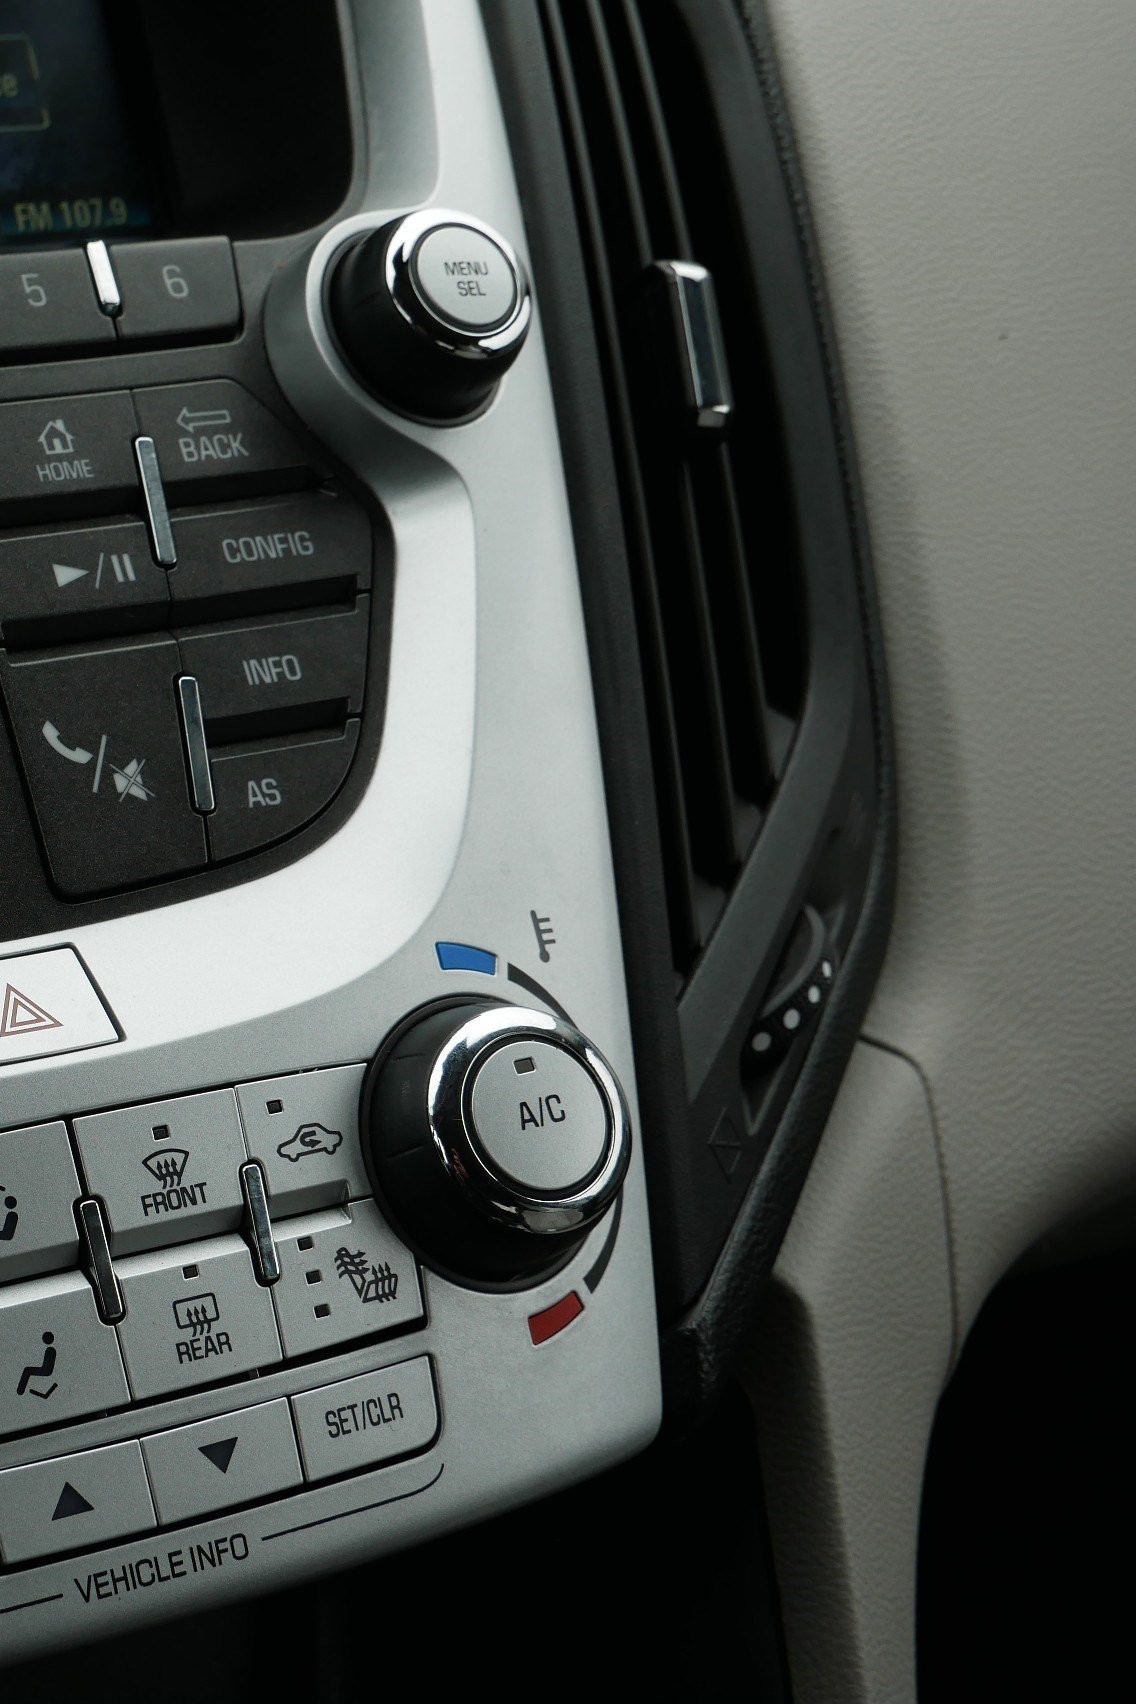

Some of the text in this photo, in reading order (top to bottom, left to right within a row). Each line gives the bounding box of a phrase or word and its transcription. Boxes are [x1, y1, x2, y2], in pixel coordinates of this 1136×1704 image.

[14, 197, 128, 232] FM 107.9
[162, 264, 190, 299] 6
[444, 261, 489, 276] MENU
[21, 272, 48, 308] 5
[456, 281, 486, 296] SEL
[178, 433, 250, 463] BACK
[36, 459, 95, 483] HOME
[221, 531, 315, 565] CONFIG
[242, 654, 302, 686] INFO
[246, 778, 282, 808] AS
[518, 1093, 567, 1132] A/C
[140, 1181, 209, 1217] FRONT
[174, 1330, 234, 1364] REAR
[324, 1392, 405, 1440] SET/CLR
[73, 1530, 251, 1604] VEHICLE INFO
